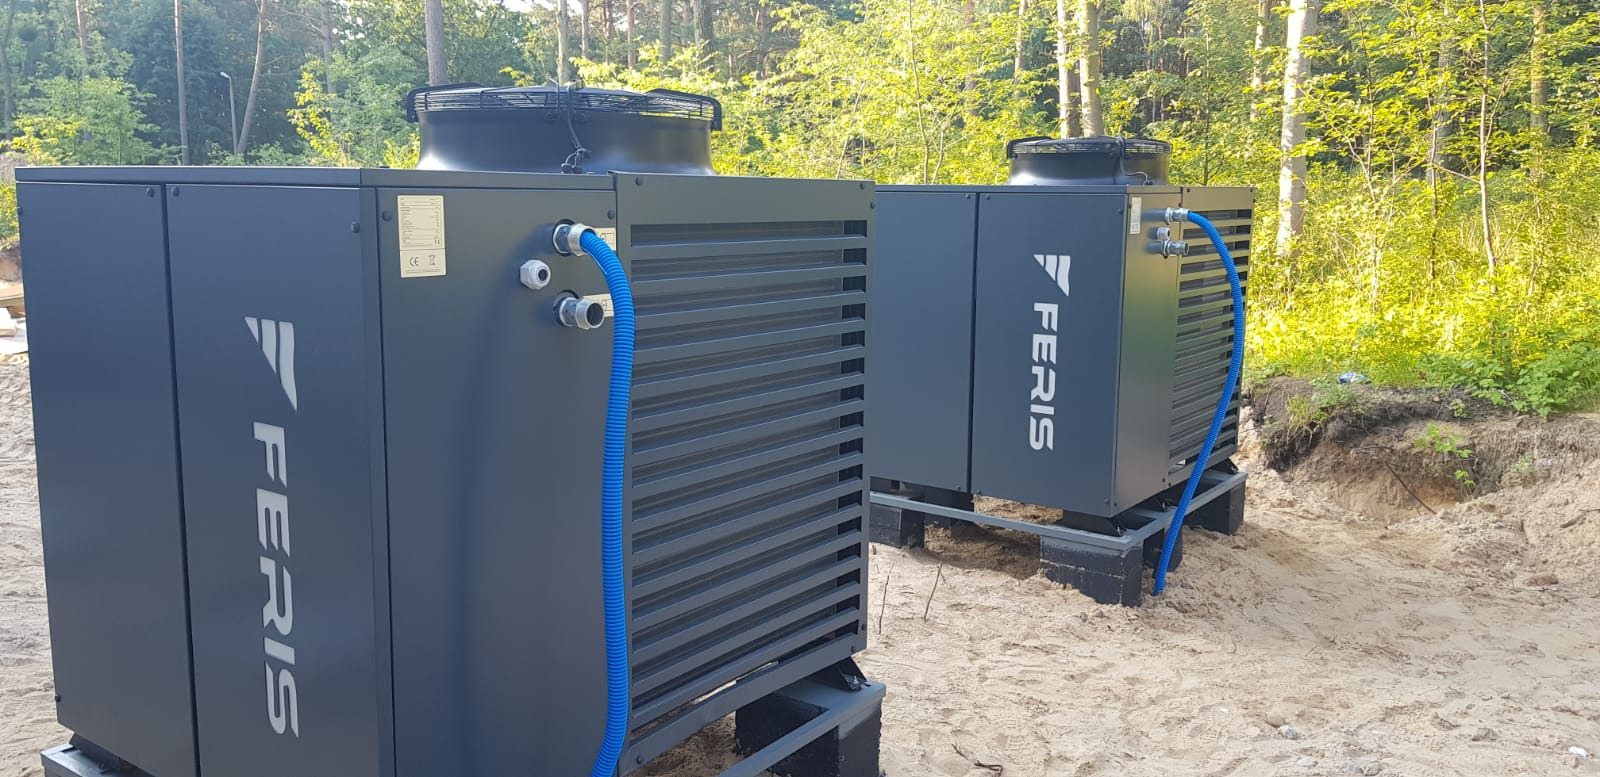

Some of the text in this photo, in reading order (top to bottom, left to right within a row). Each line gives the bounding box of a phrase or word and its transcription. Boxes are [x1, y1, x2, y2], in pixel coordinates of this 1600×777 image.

[410, 256, 420, 266] CE
[1029, 302, 1059, 450] FERIS
[252, 421, 300, 739] FERIS
